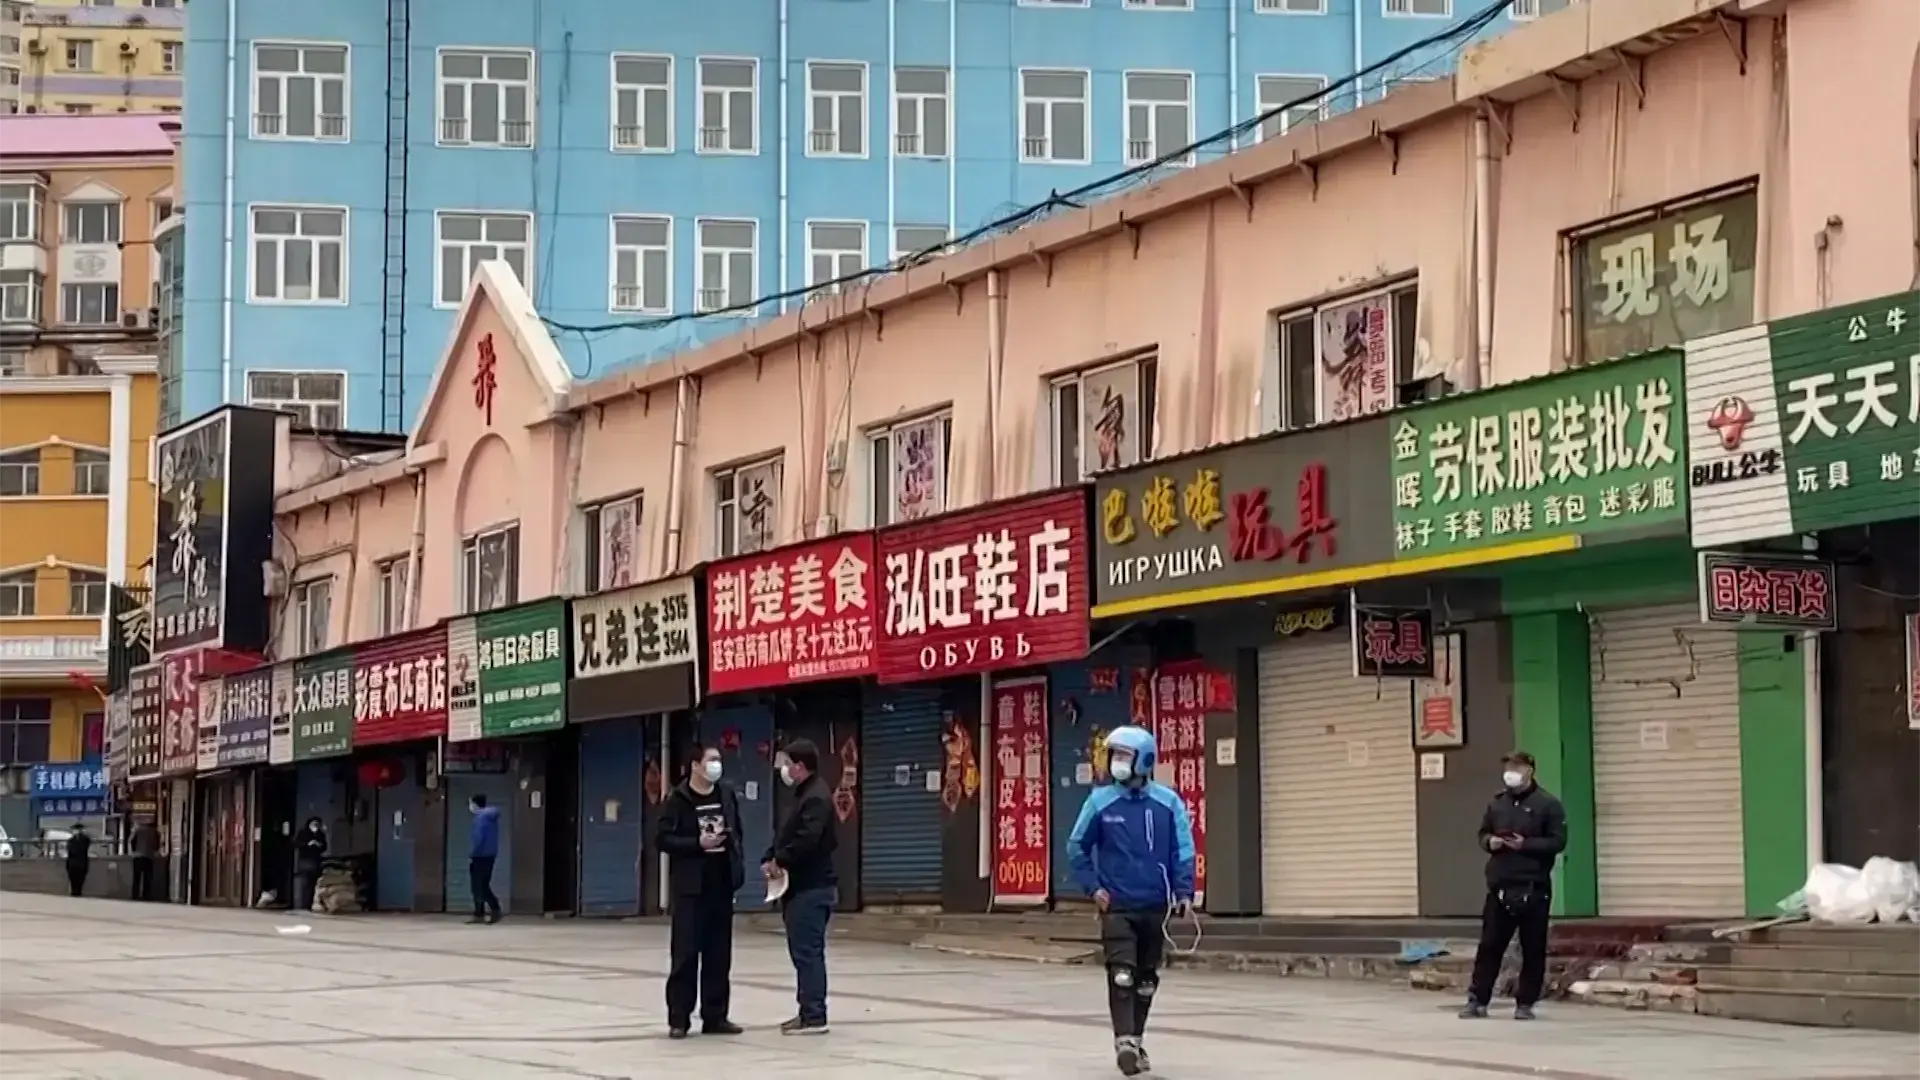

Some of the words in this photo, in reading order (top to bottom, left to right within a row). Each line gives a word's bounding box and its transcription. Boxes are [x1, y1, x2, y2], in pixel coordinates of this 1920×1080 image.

[1601, 214, 1728, 322] 现场
[1848, 307, 1907, 342] 公牛
[1787, 354, 1920, 444] 天天
[1394, 418, 1423, 508] 金晖
[1428, 377, 1676, 506] 劳保服装批发
[1443, 509, 1484, 543] 手套
[1491, 500, 1533, 535] 胶鞋
[1543, 494, 1586, 526] 背包
[1599, 475, 1676, 518] 迷彩服
[1797, 461, 1850, 493] 玩具
[713, 546, 868, 632] 荆楚美食
[885, 519, 1070, 636] 泓旺鞋店
[1108, 544, 1225, 586] ИГРУШКА
[1712, 566, 1828, 618] 日杂百货
[579, 602, 660, 671] 兄弟连
[920, 633, 1031, 670] ОБУВЬ
[1364, 620, 1426, 664] 玩具
[999, 854, 1044, 890] обувь
